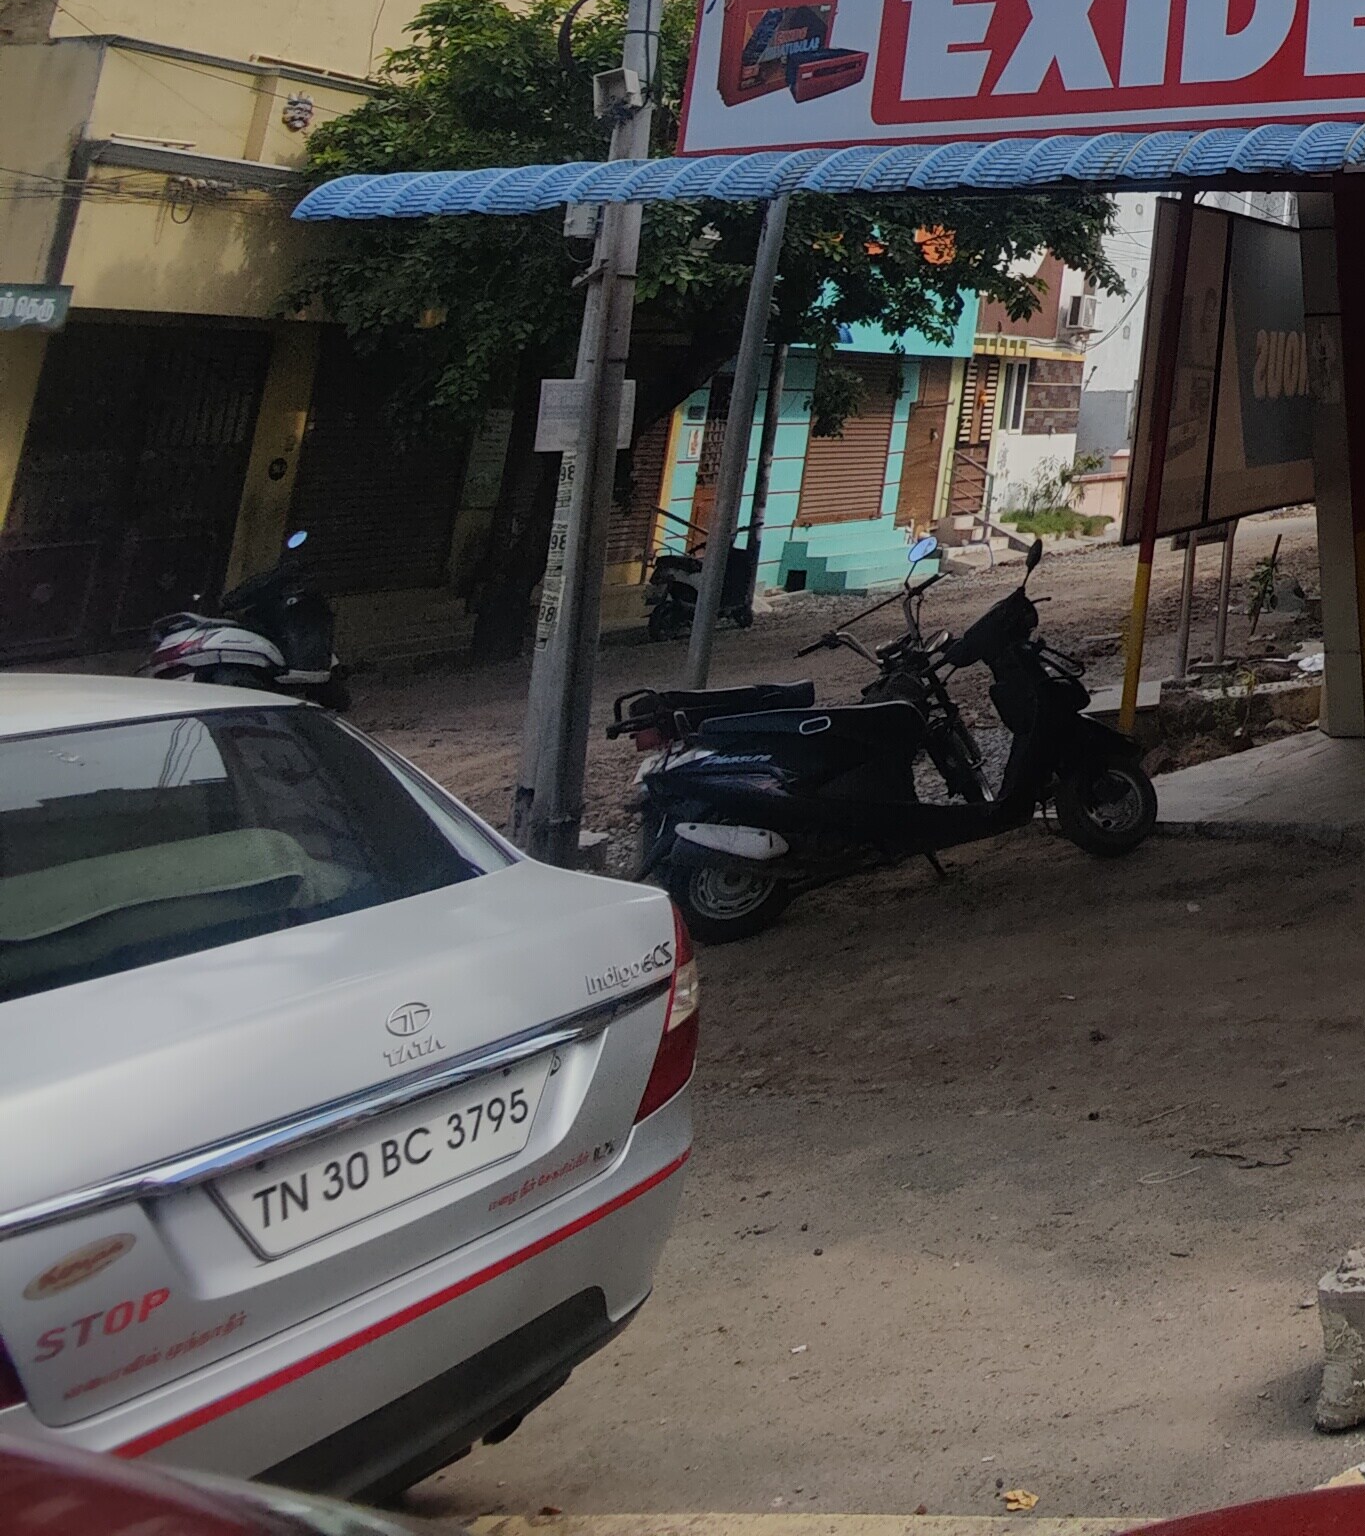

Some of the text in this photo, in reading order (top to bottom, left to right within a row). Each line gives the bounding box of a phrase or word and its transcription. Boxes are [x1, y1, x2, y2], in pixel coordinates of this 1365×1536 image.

[584, 962, 640, 996] Indigo
[383, 1034, 448, 1068] TATA
[252, 1087, 531, 1230] TN 30 BC 3795
[33, 1286, 171, 1363] STOP
